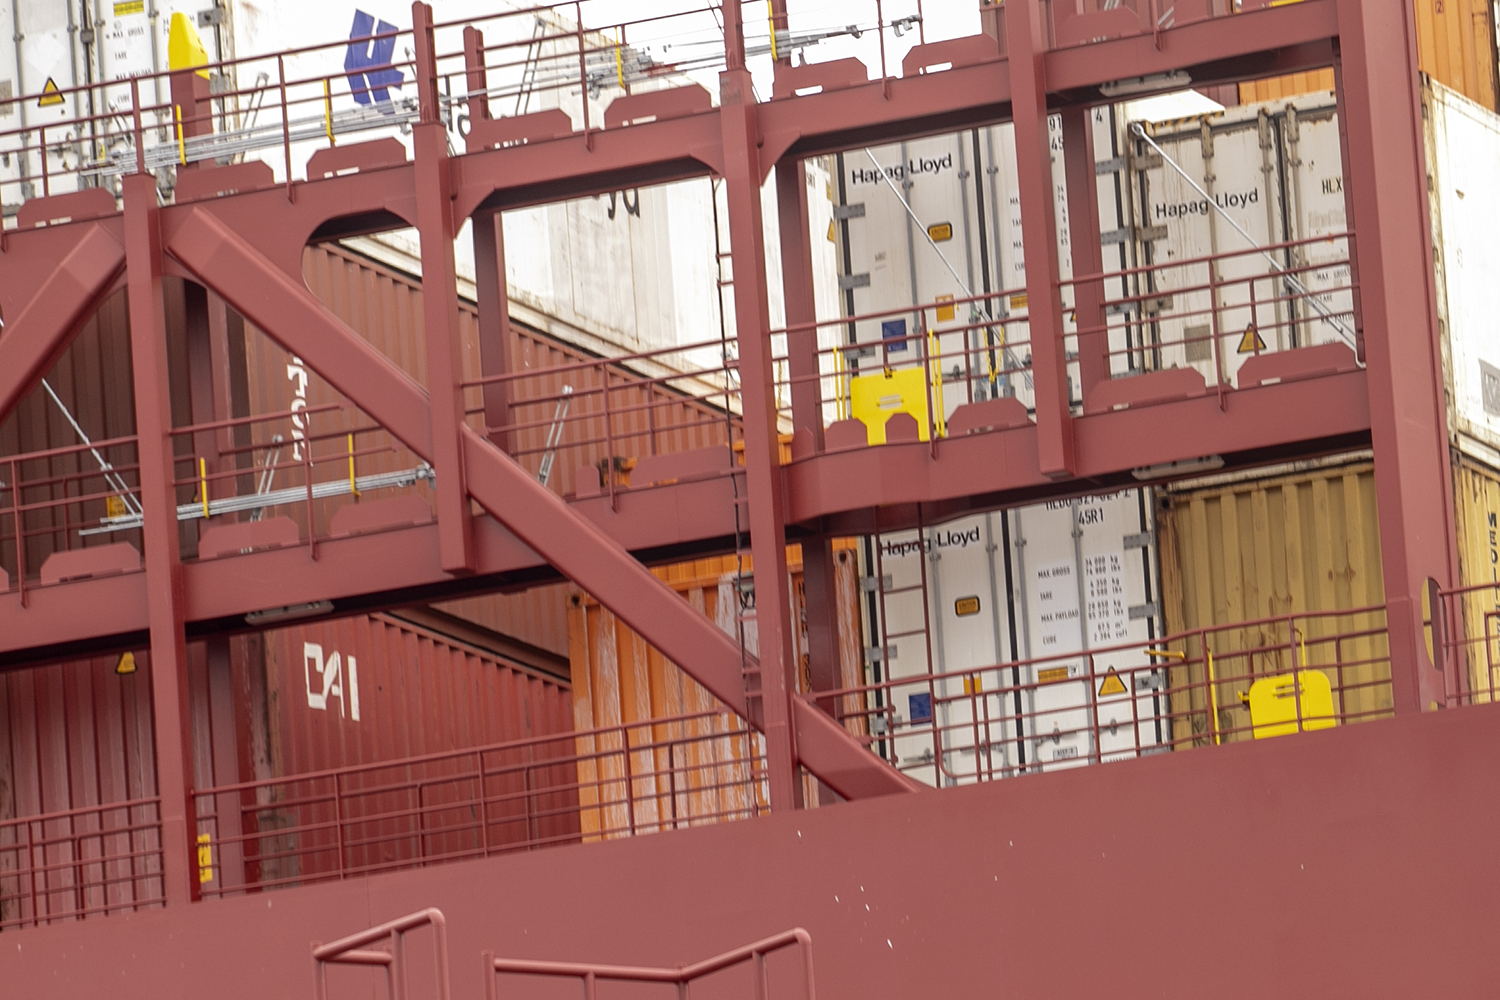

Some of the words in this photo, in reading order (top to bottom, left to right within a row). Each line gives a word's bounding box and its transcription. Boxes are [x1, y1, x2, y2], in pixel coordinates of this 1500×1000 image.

[852, 153, 952, 184] HapagLloyd
[1321, 177, 1343, 195] HLX
[1156, 188, 1259, 219] HapagLloyd
[1078, 507, 1105, 526] 45R1
[879, 526, 980, 557] HapagLloyd
[1055, 609, 1079, 622] PAYLOAD
[303, 641, 360, 722] CAI
